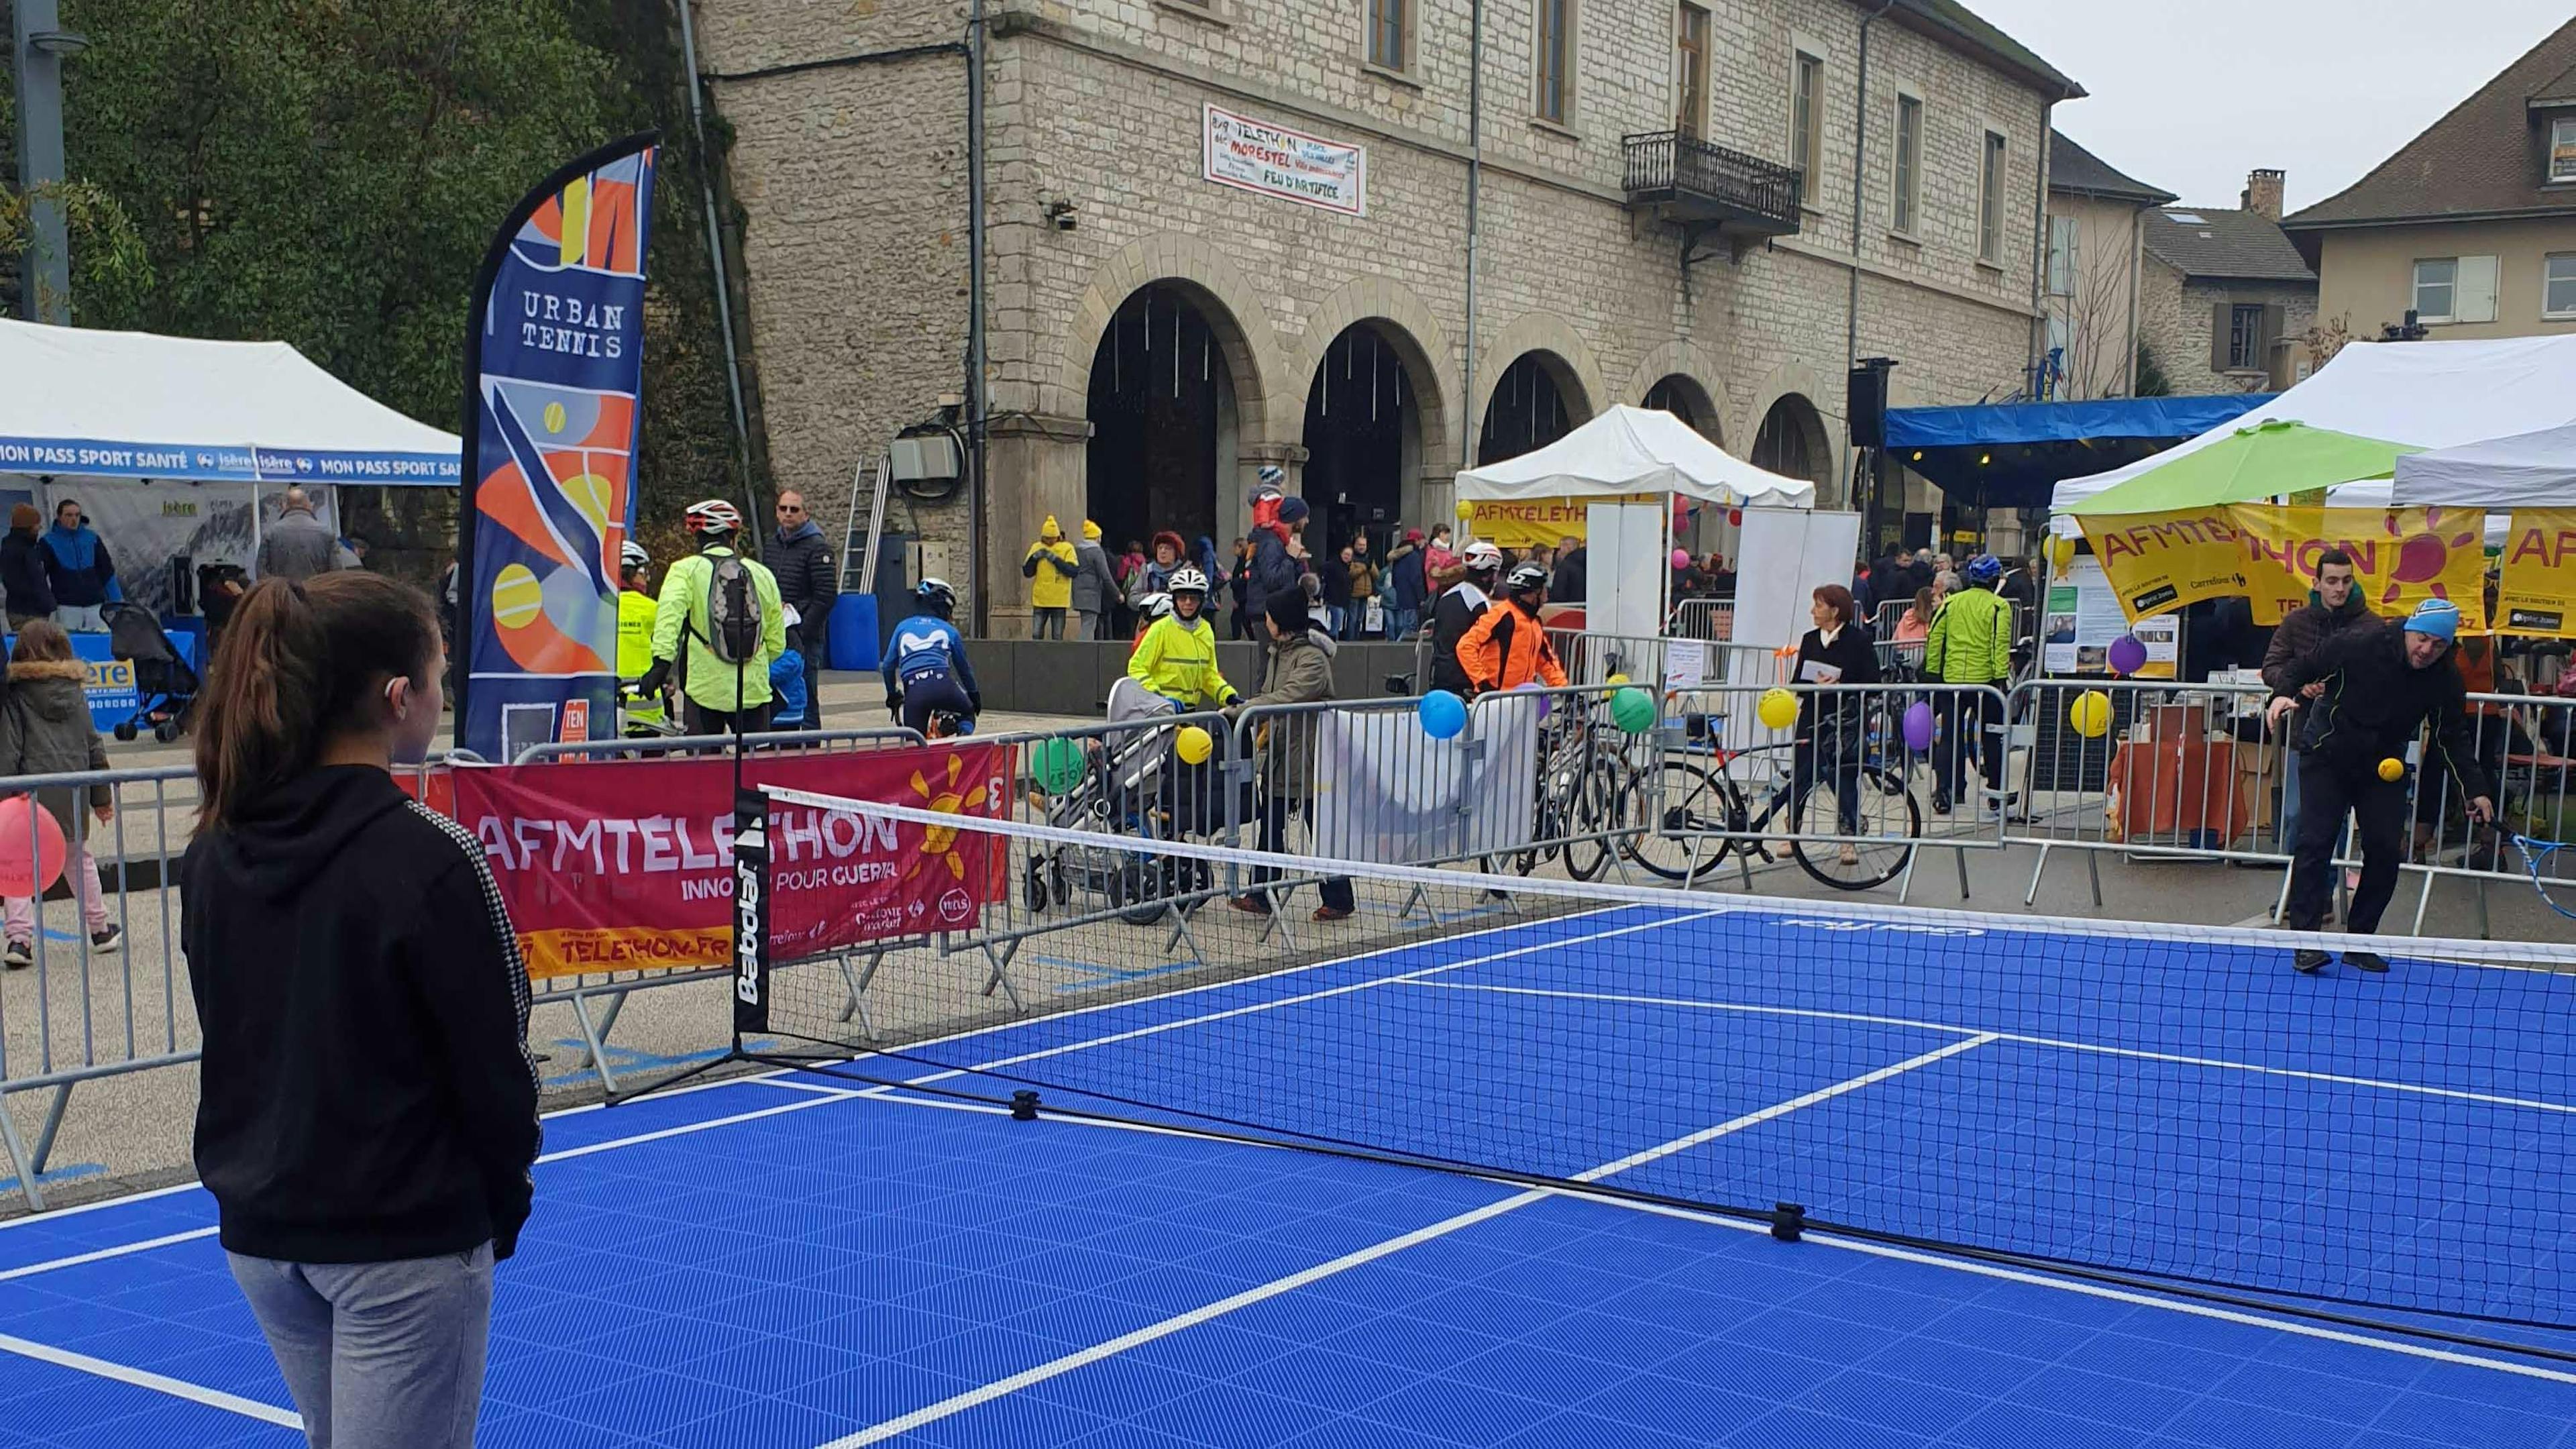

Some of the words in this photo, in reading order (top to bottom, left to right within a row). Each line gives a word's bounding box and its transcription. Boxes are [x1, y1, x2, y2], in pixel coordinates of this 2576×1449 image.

[1230, 140, 1291, 168] MORESTEL
[1264, 169, 1284, 186] FEU
[1285, 175, 1339, 200] D'ARTIFICE
[523, 290, 625, 331] URBAN
[523, 322, 622, 358] TENNIS
[34, 447, 76, 464] PASS
[78, 449, 133, 467] SPORT
[136, 450, 189, 469] SANTÉ
[320, 460, 354, 474] MON
[356, 460, 391, 475] PASS
[392, 461, 437, 476] SPORT
[566, 710, 584, 729] TEN
[681, 877, 735, 901] INNO
[775, 868, 828, 892] POUR
[737, 859, 759, 1006] Babolat
